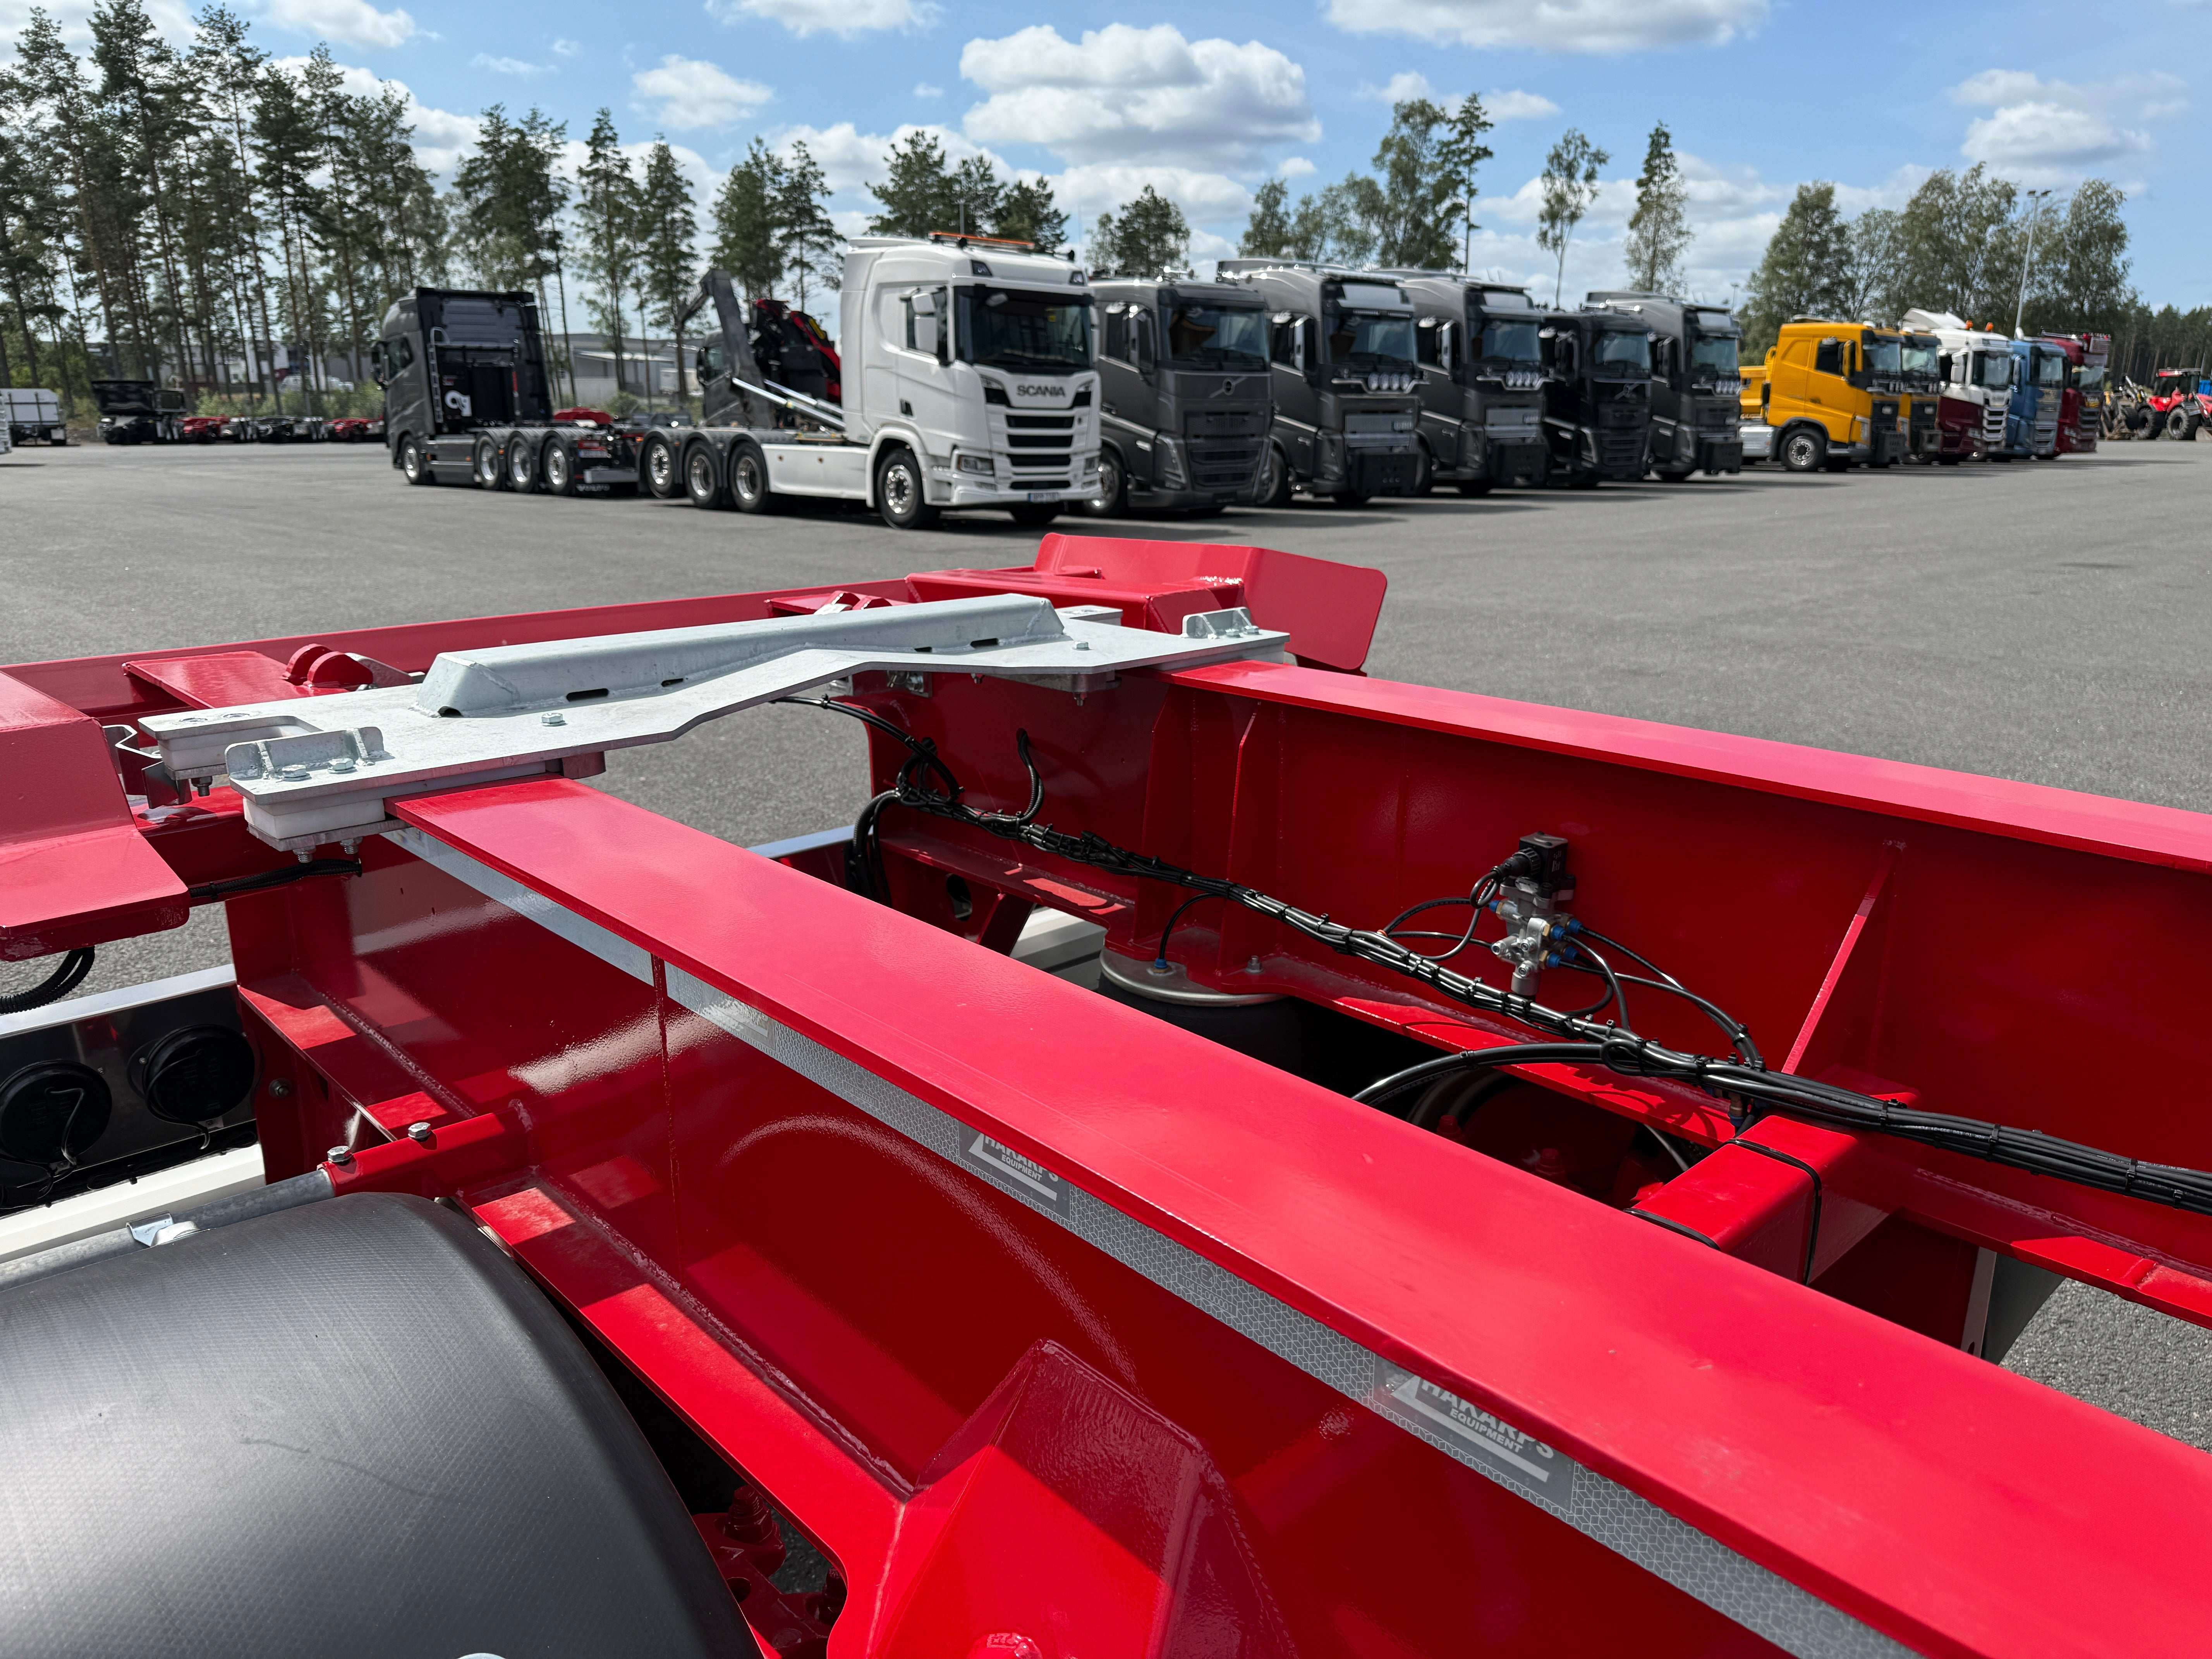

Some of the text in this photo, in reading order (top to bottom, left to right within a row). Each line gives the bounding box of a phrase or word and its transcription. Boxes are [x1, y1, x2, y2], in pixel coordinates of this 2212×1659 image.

[1017, 385, 1066, 397] SCANIA
[1001, 1154, 1042, 1181] EQUIPMENT
[1450, 1408, 1523, 1453] EQUIPMENT
